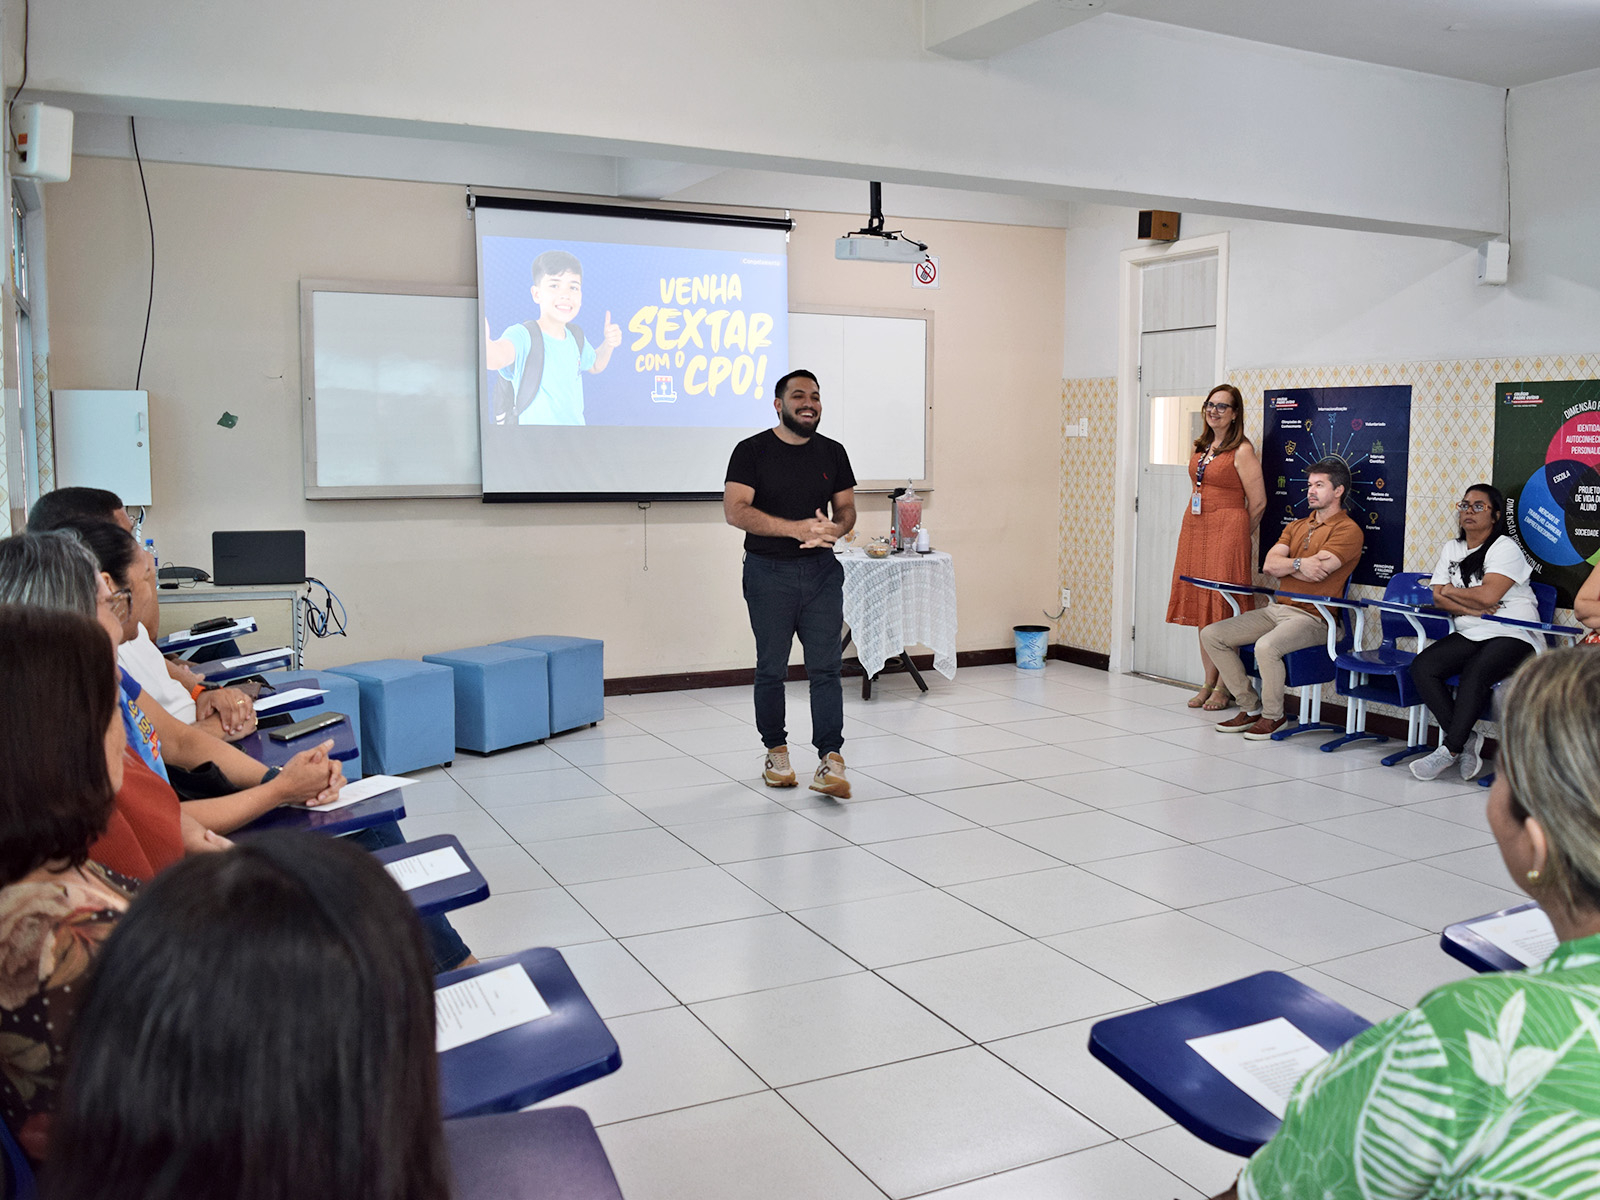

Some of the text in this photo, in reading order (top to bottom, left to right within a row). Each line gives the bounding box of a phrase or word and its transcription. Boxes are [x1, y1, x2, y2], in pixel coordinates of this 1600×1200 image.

[660, 274, 742, 305] VENHA
[628, 305, 774, 355] SEXTAR
[635, 350, 768, 400] COM O CPO!
[1563, 399, 1597, 420] DIMENSÃO
[1553, 470, 1571, 484] ESCOLA
[1574, 494, 1582, 503] DE
[1582, 494, 1594, 503] VIDA
[1580, 503, 1597, 511] ALUNO
[1505, 498, 1517, 535] DIMENSÃO
[1538, 506, 1555, 522] MERCADO
[1574, 528, 1599, 537] SOCIEDADE
